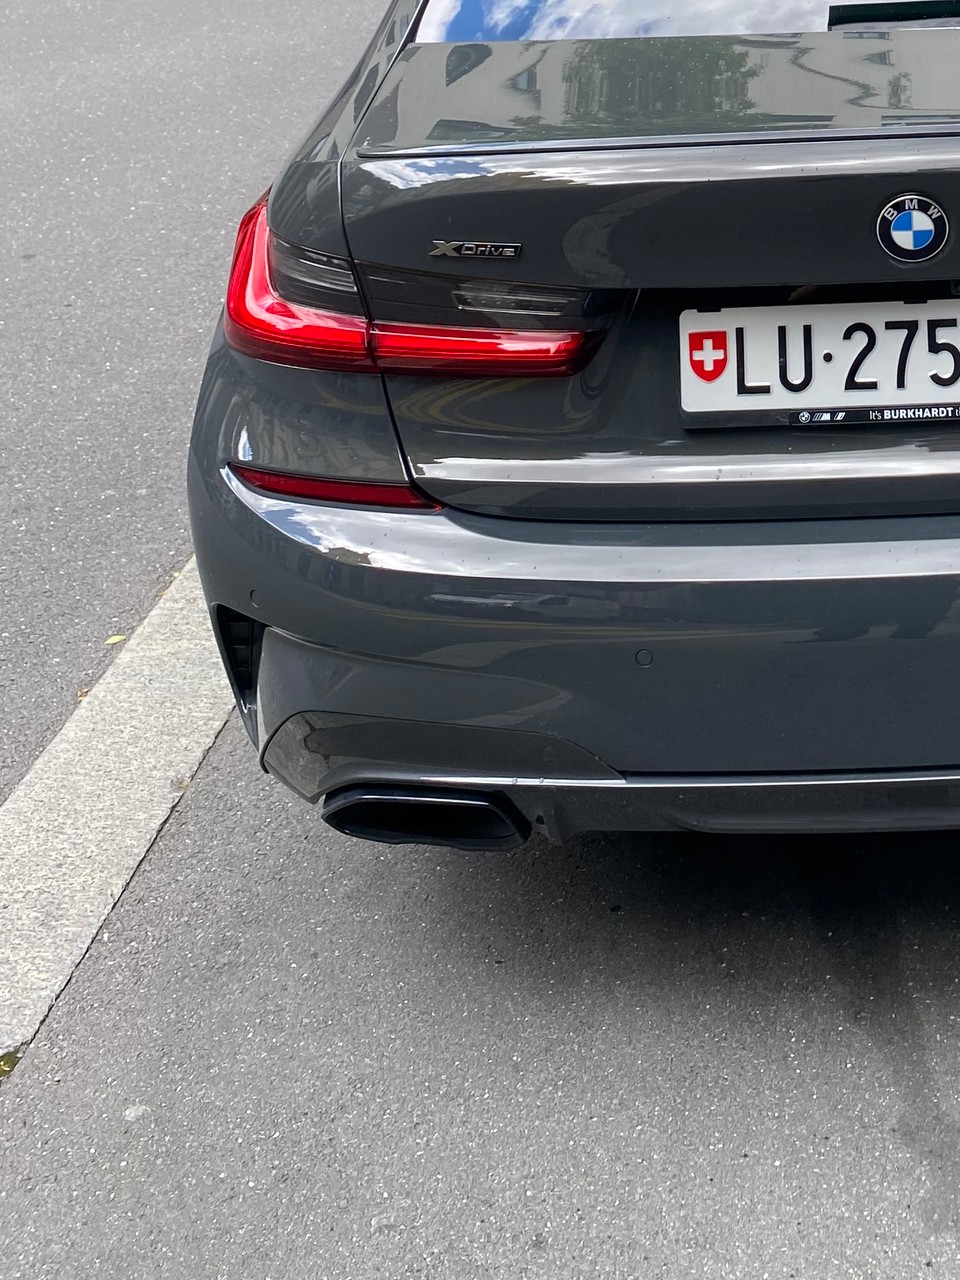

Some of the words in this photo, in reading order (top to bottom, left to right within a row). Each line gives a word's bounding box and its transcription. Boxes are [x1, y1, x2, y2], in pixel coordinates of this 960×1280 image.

[883, 199, 942, 221] BMW
[869, 409, 882, 421] It's
[883, 407, 954, 420] BURKHARDT
